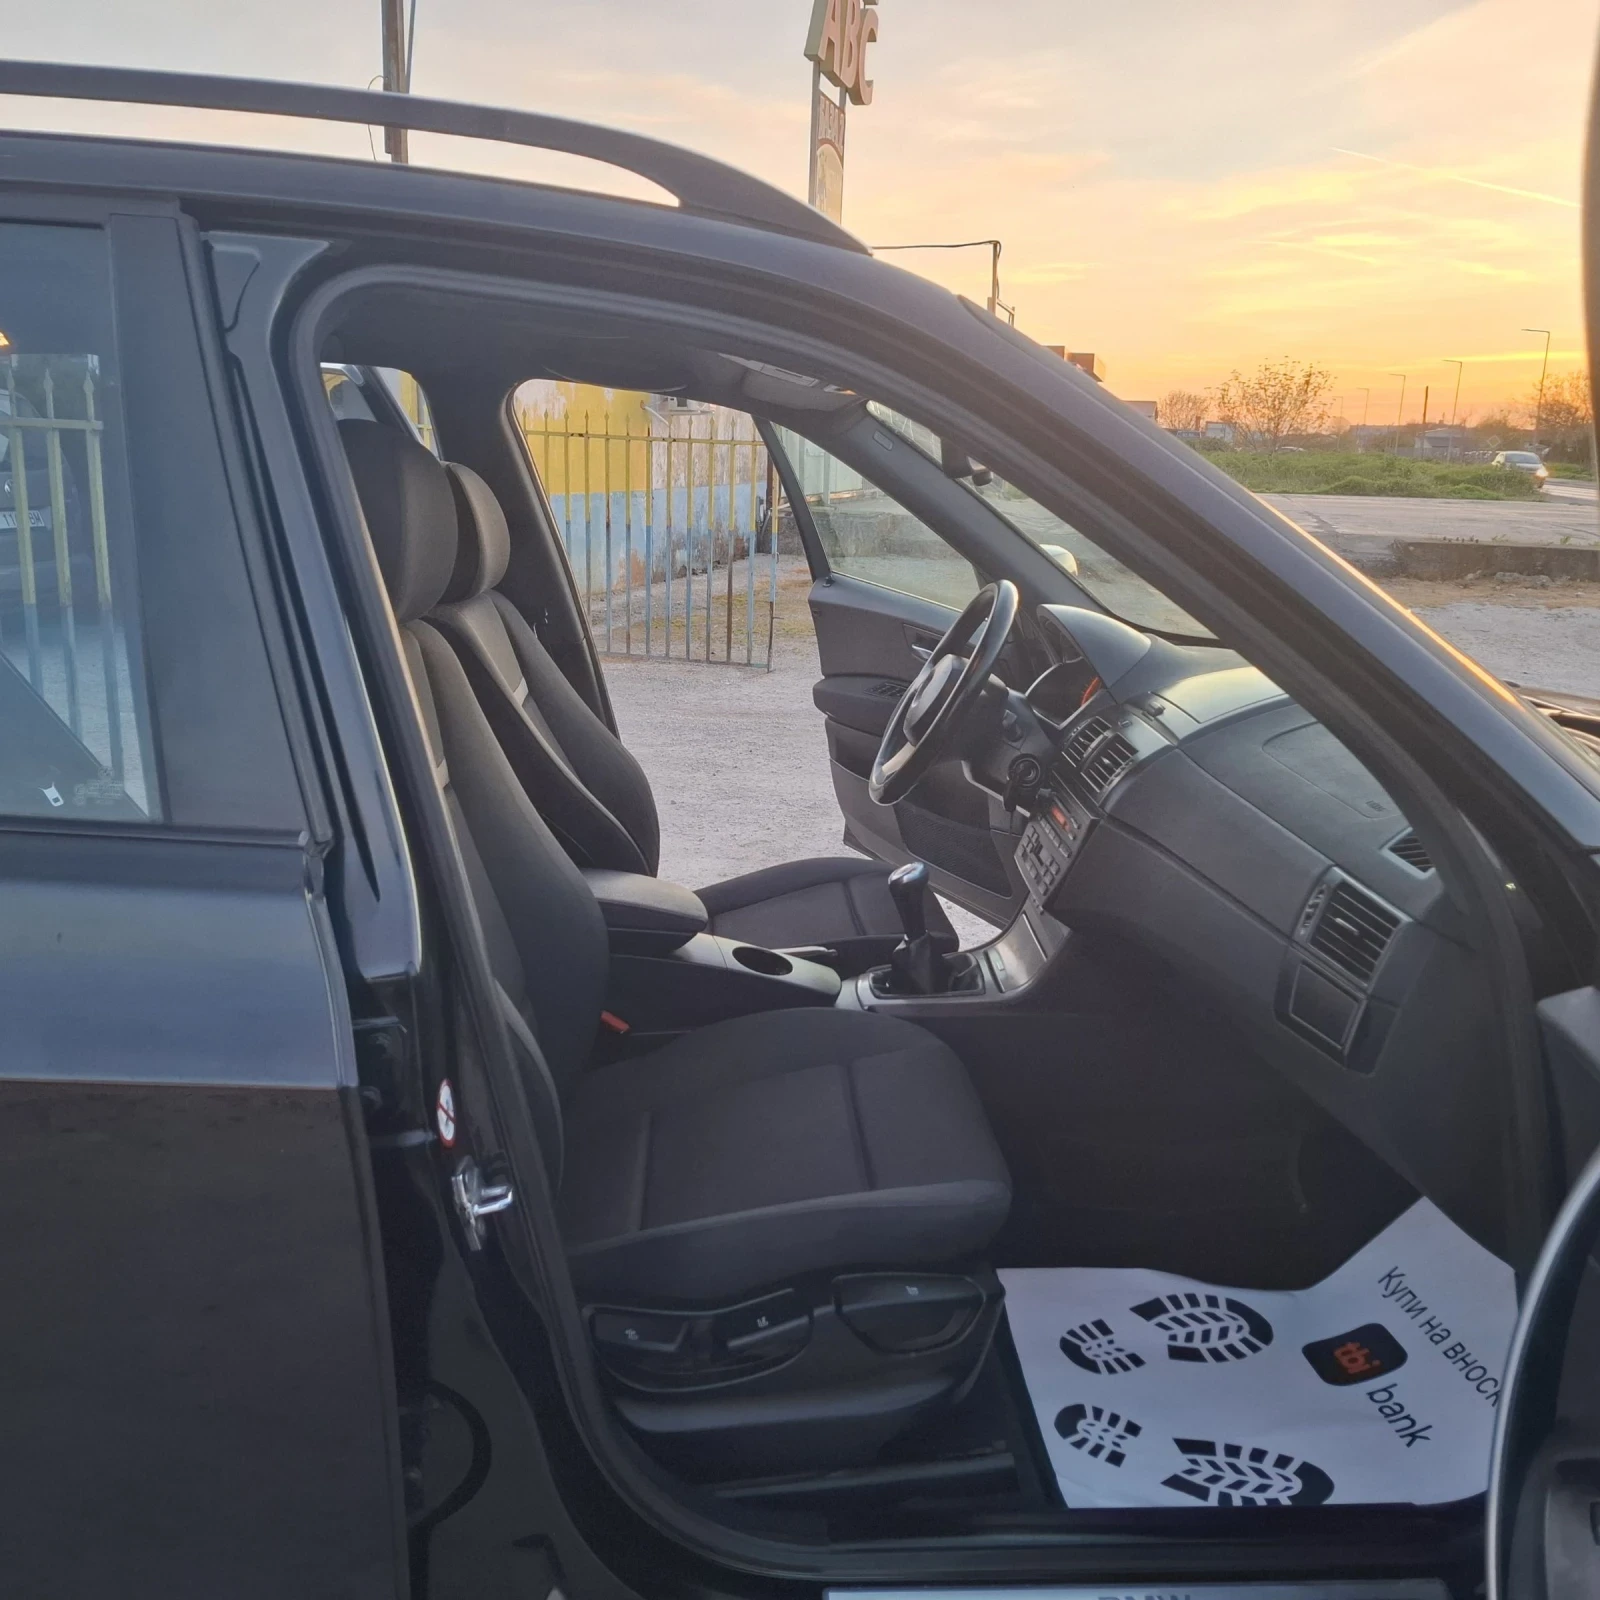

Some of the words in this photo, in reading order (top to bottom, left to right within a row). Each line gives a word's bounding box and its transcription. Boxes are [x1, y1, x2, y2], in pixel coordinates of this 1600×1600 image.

[817, 0, 879, 105] ABC
[1378, 1266, 1428, 1320] Купи
[1418, 1315, 1452, 1346] на
[1366, 1383, 1433, 1448] bank
